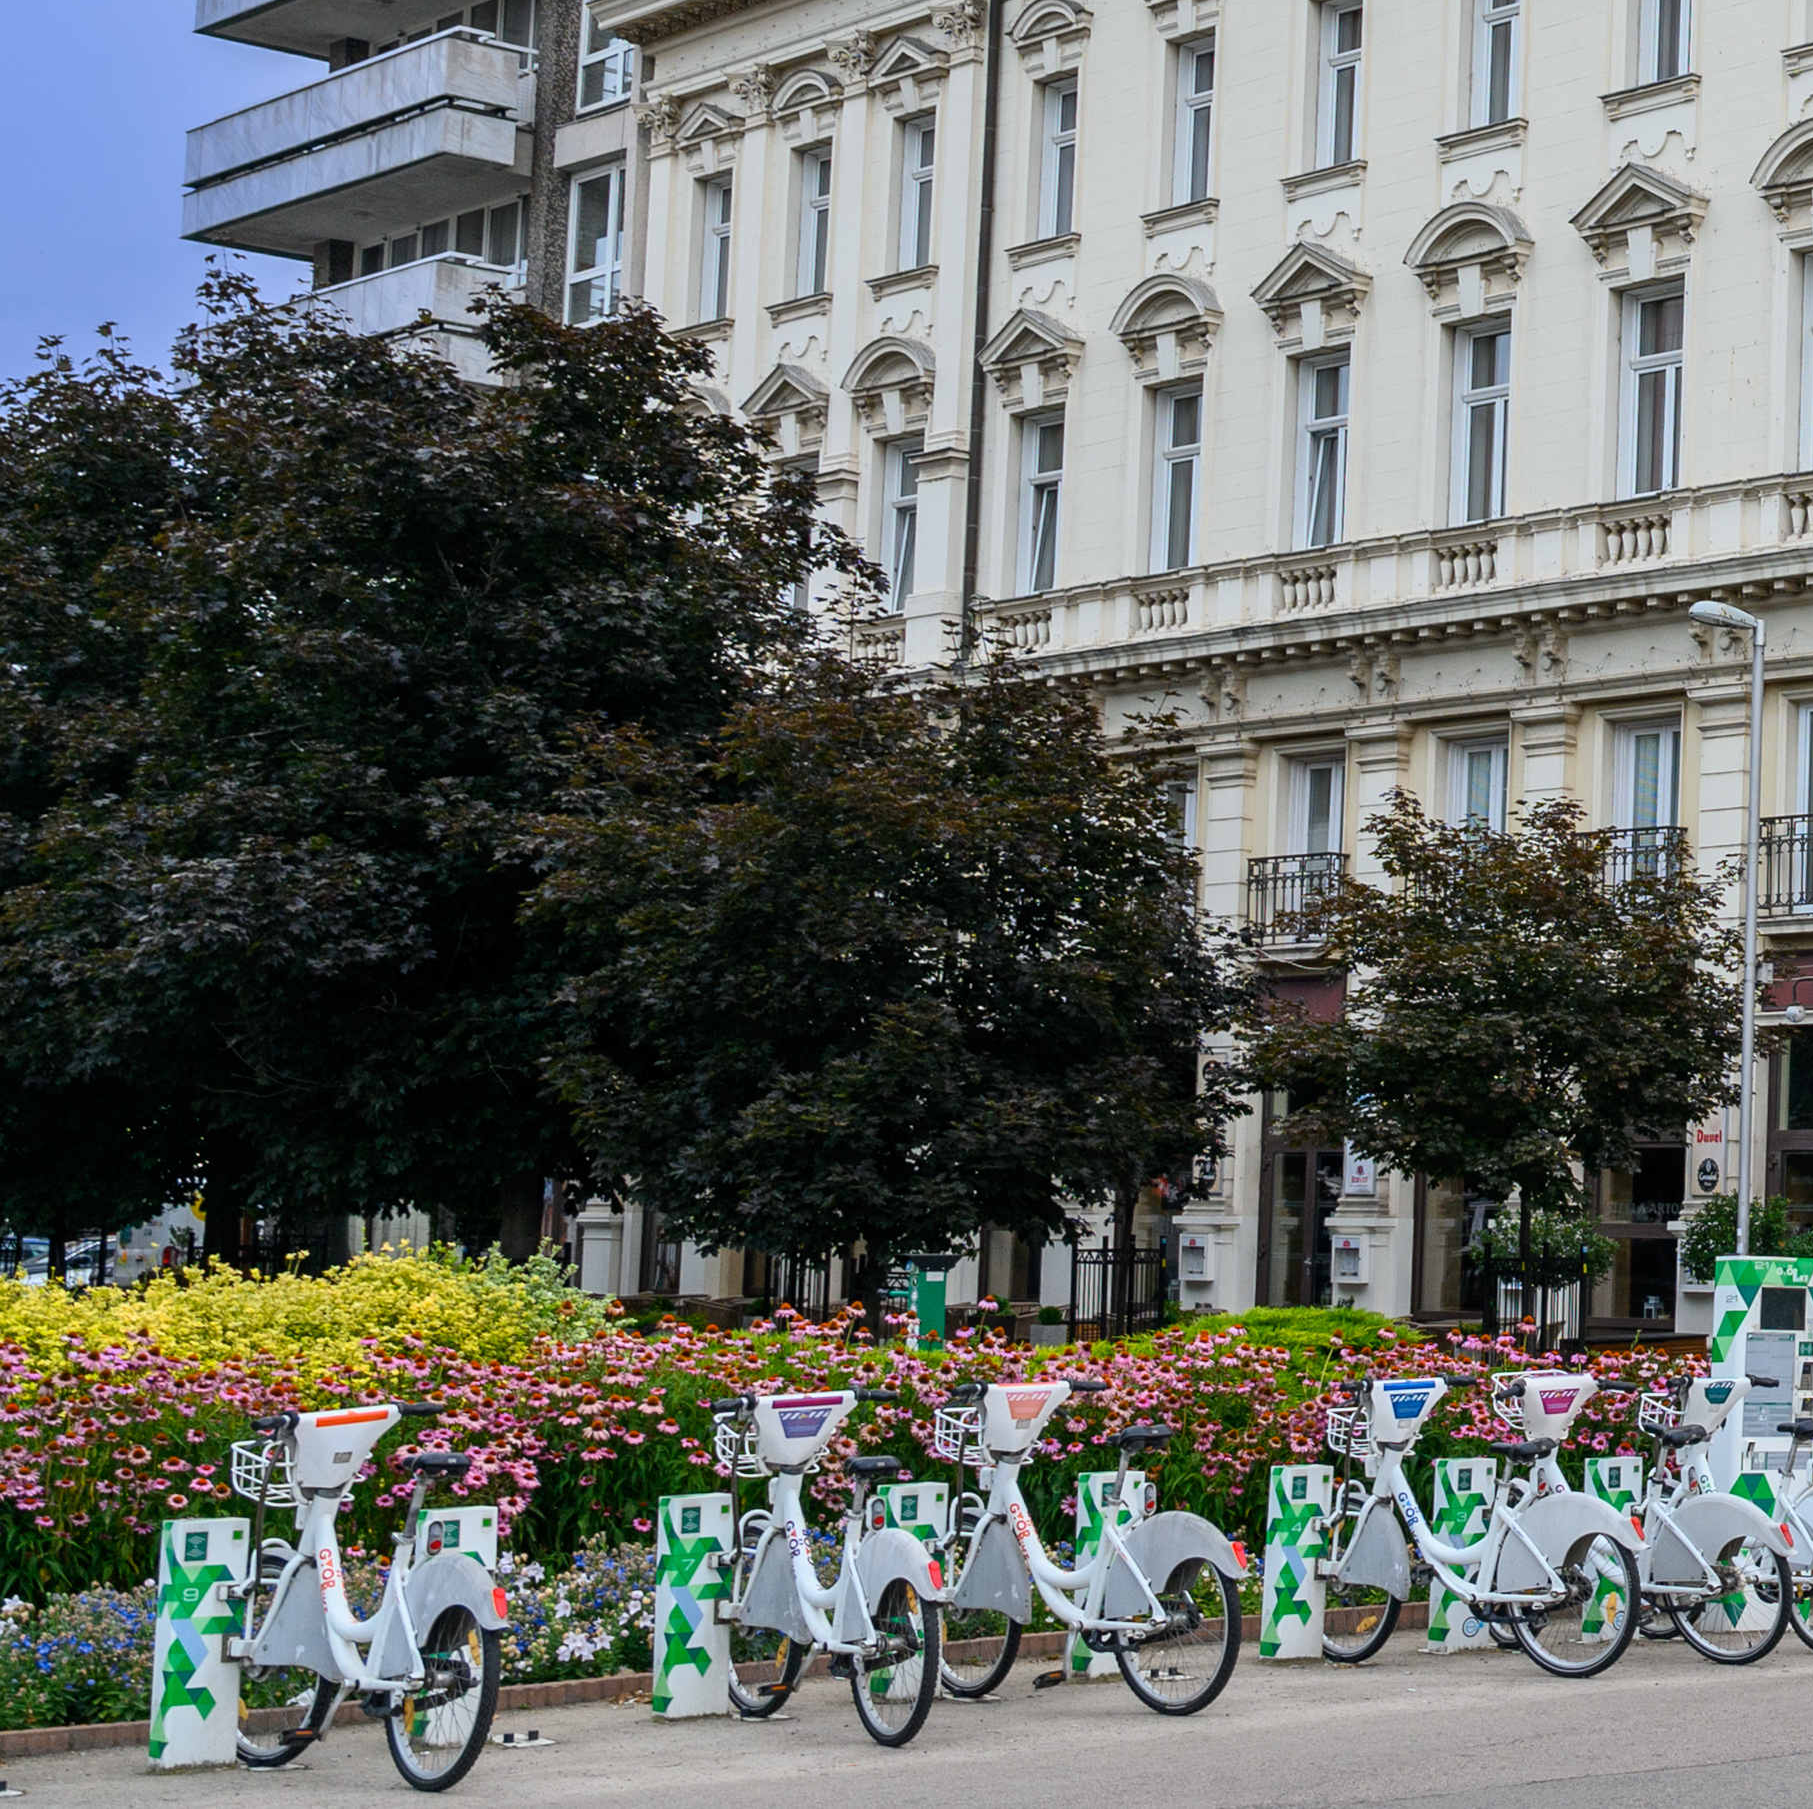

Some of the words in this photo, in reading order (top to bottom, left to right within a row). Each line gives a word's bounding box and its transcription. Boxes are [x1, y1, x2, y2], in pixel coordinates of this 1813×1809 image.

[1697, 1128, 1723, 1143] Duvel
[1754, 1261, 1770, 1270] 21
[1725, 1294, 1739, 1303] 21
[1456, 1511, 1467, 1522] 3
[1291, 1524, 1302, 1533] 4
[681, 1558, 695, 1571] 7
[182, 1587, 199, 1602] 9
